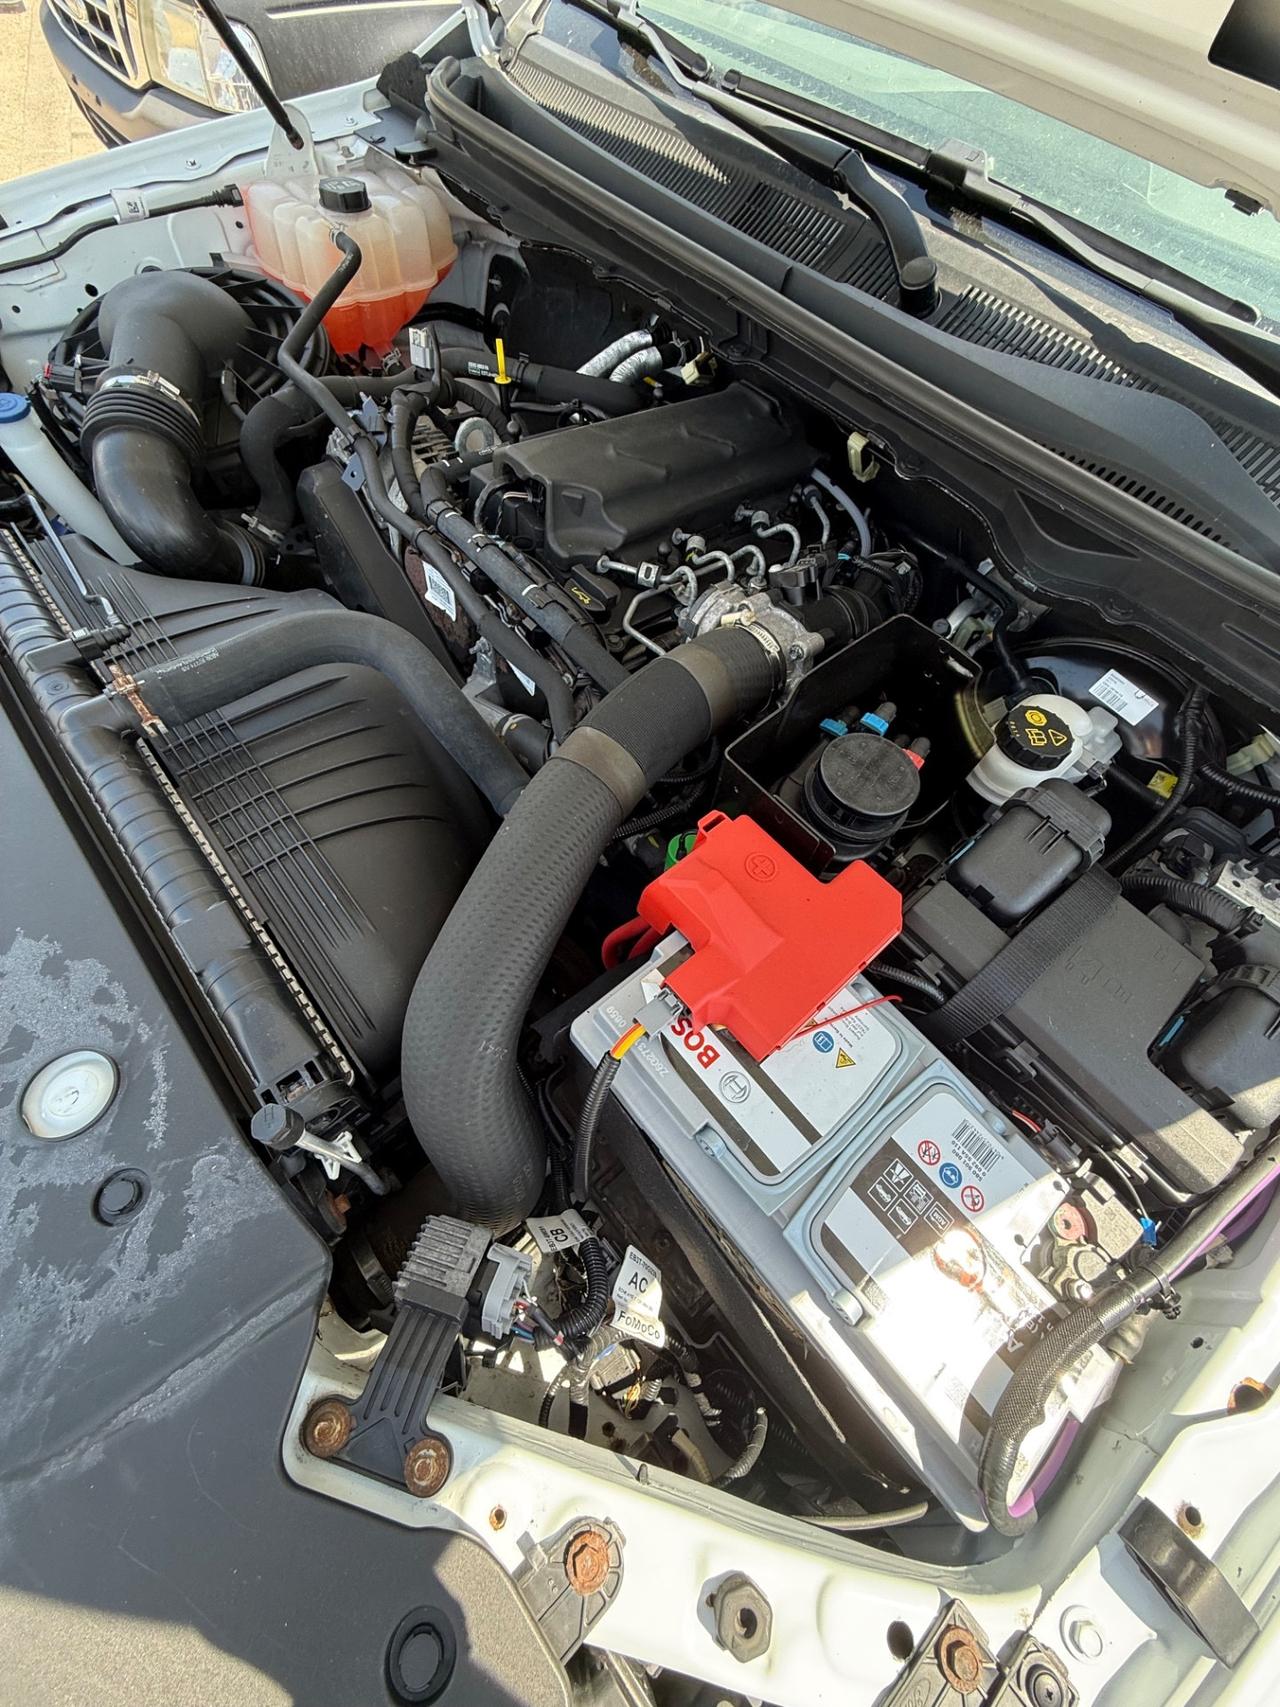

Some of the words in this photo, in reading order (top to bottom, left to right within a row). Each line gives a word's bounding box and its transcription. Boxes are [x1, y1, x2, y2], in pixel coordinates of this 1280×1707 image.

[671, 1016, 721, 1070] BOS
[550, 1228, 569, 1243] CB
[628, 1271, 649, 1294] AC
[617, 1310, 661, 1340] FoMoCo
